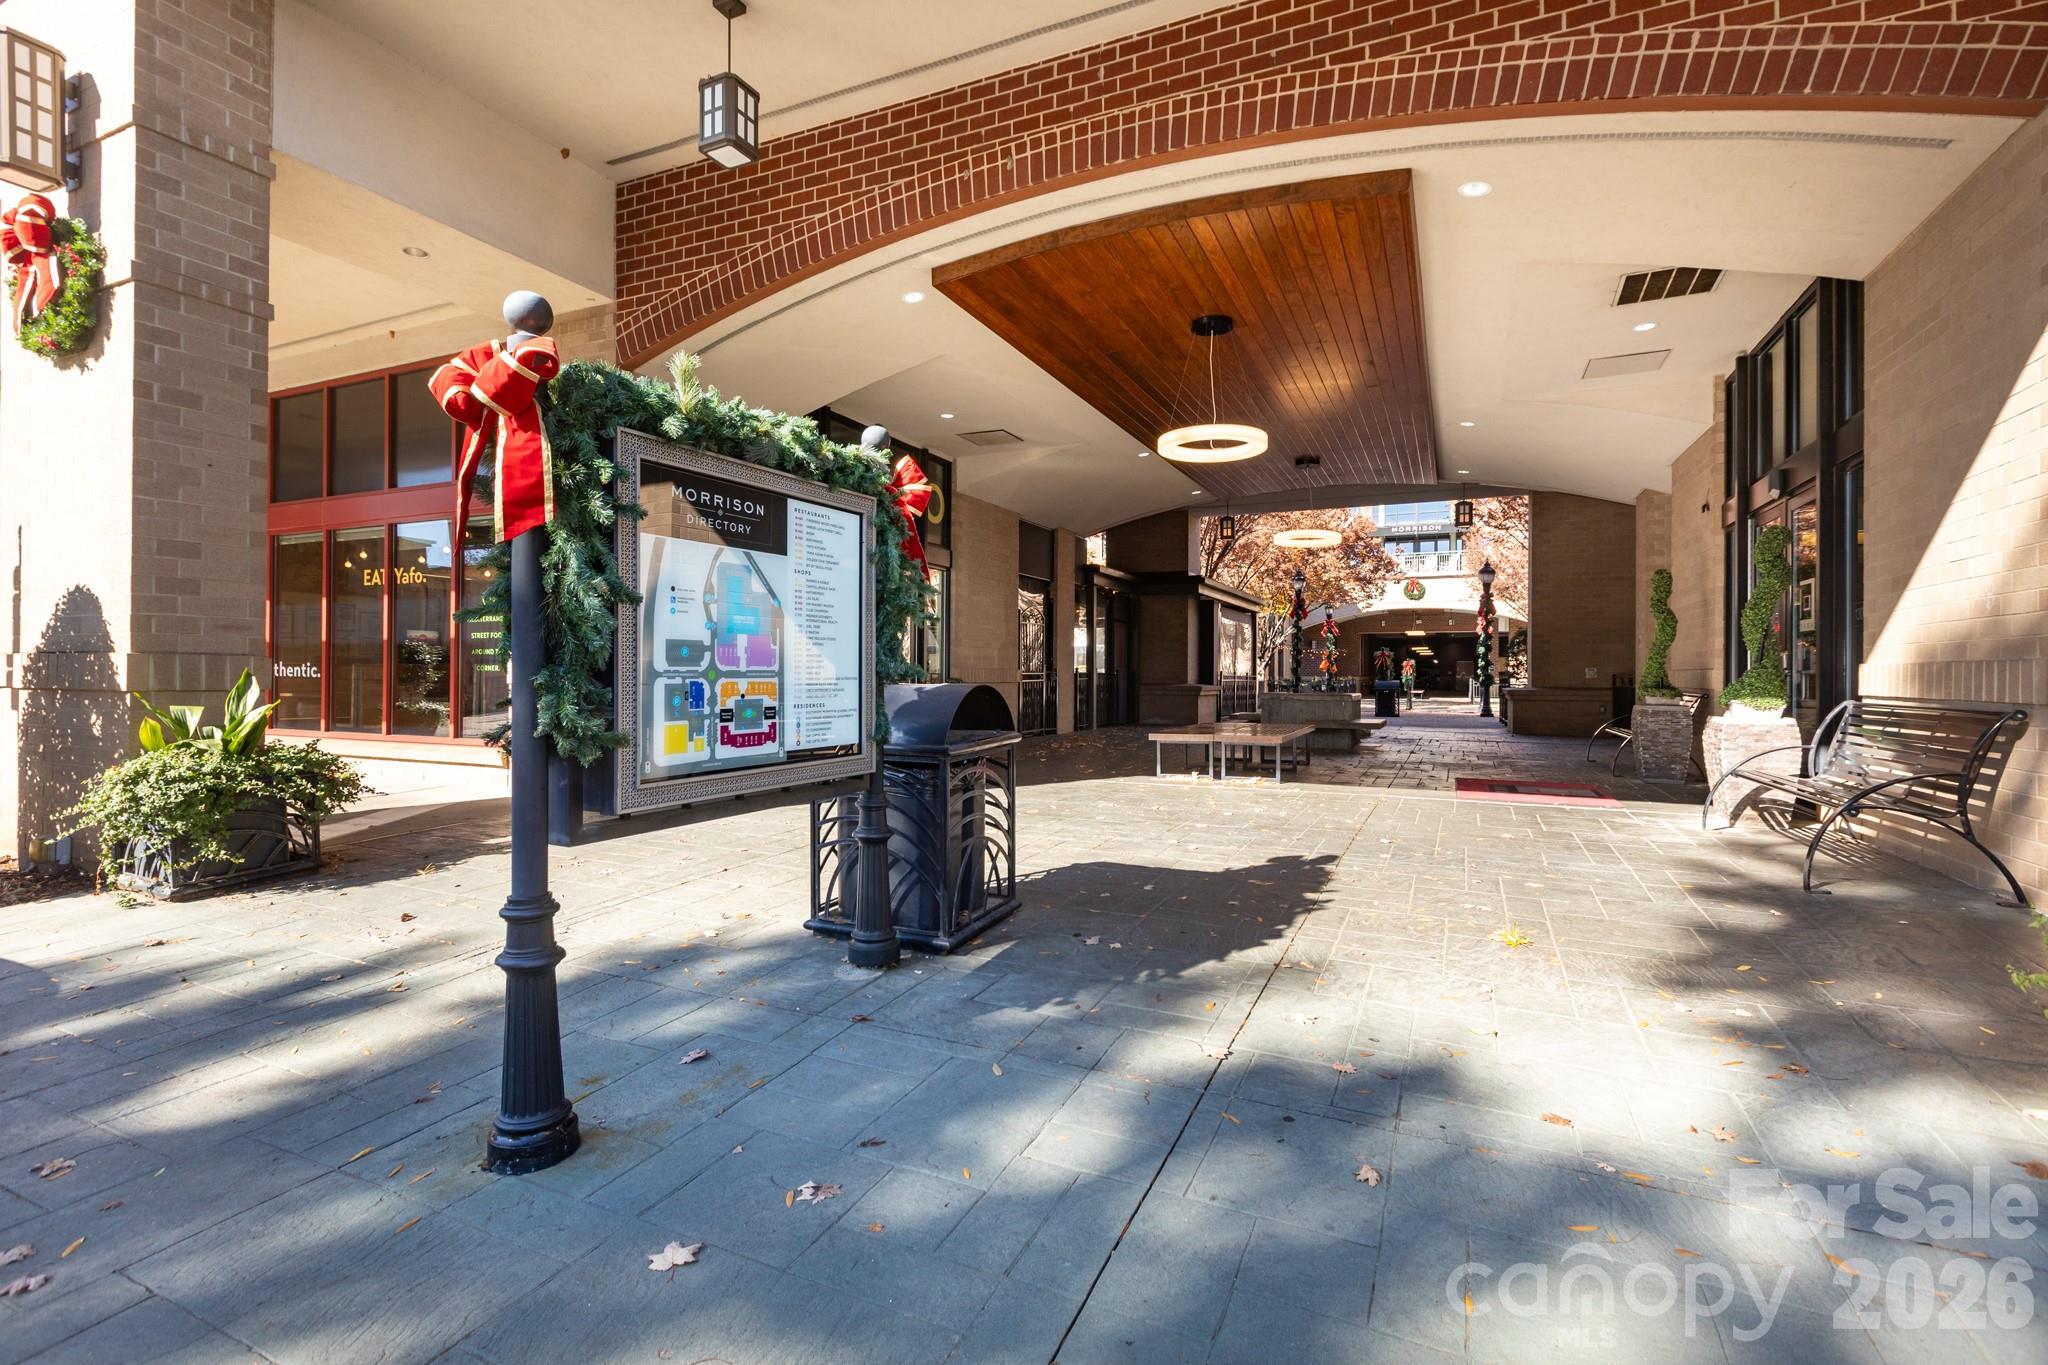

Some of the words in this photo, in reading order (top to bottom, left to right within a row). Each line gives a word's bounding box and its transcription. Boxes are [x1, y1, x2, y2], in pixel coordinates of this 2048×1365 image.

[671, 485, 765, 517] MORRISON
[686, 514, 752, 534] DIRECTORY
[1391, 525, 1442, 533] MORRISON
[394, 566, 427, 585] Yafo.
